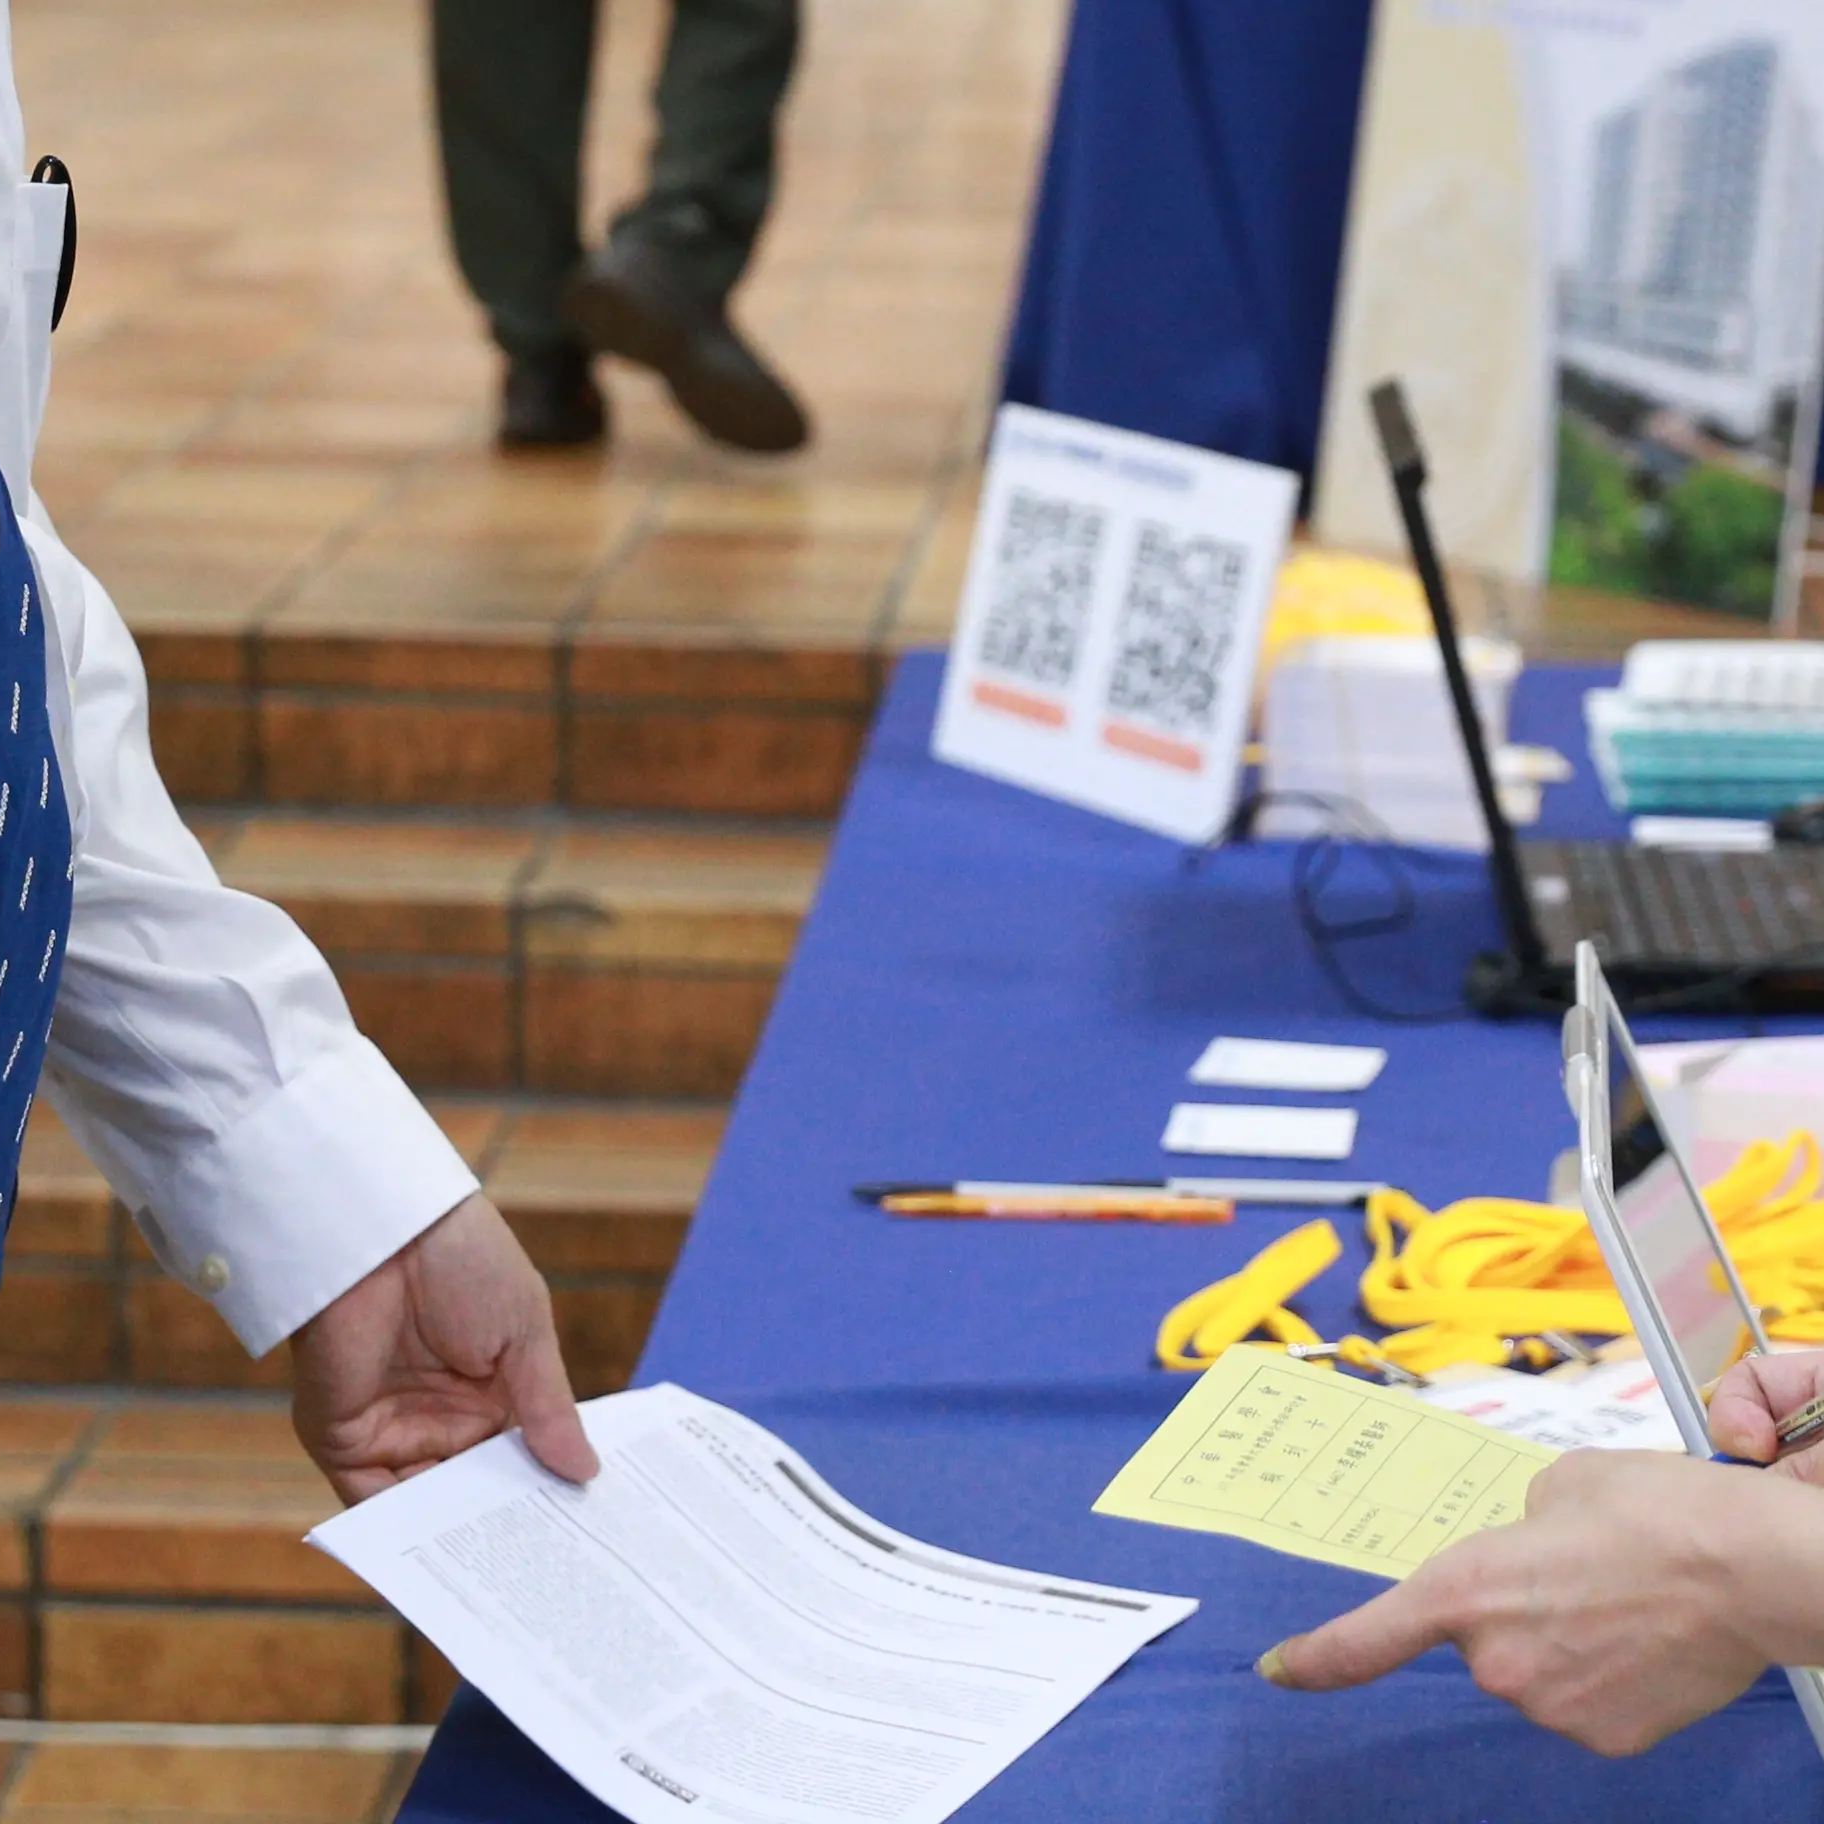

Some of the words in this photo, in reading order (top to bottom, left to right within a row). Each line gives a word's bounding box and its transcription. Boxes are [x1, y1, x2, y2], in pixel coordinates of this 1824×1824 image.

[1180, 1384, 1282, 1486] 中華醫學會
